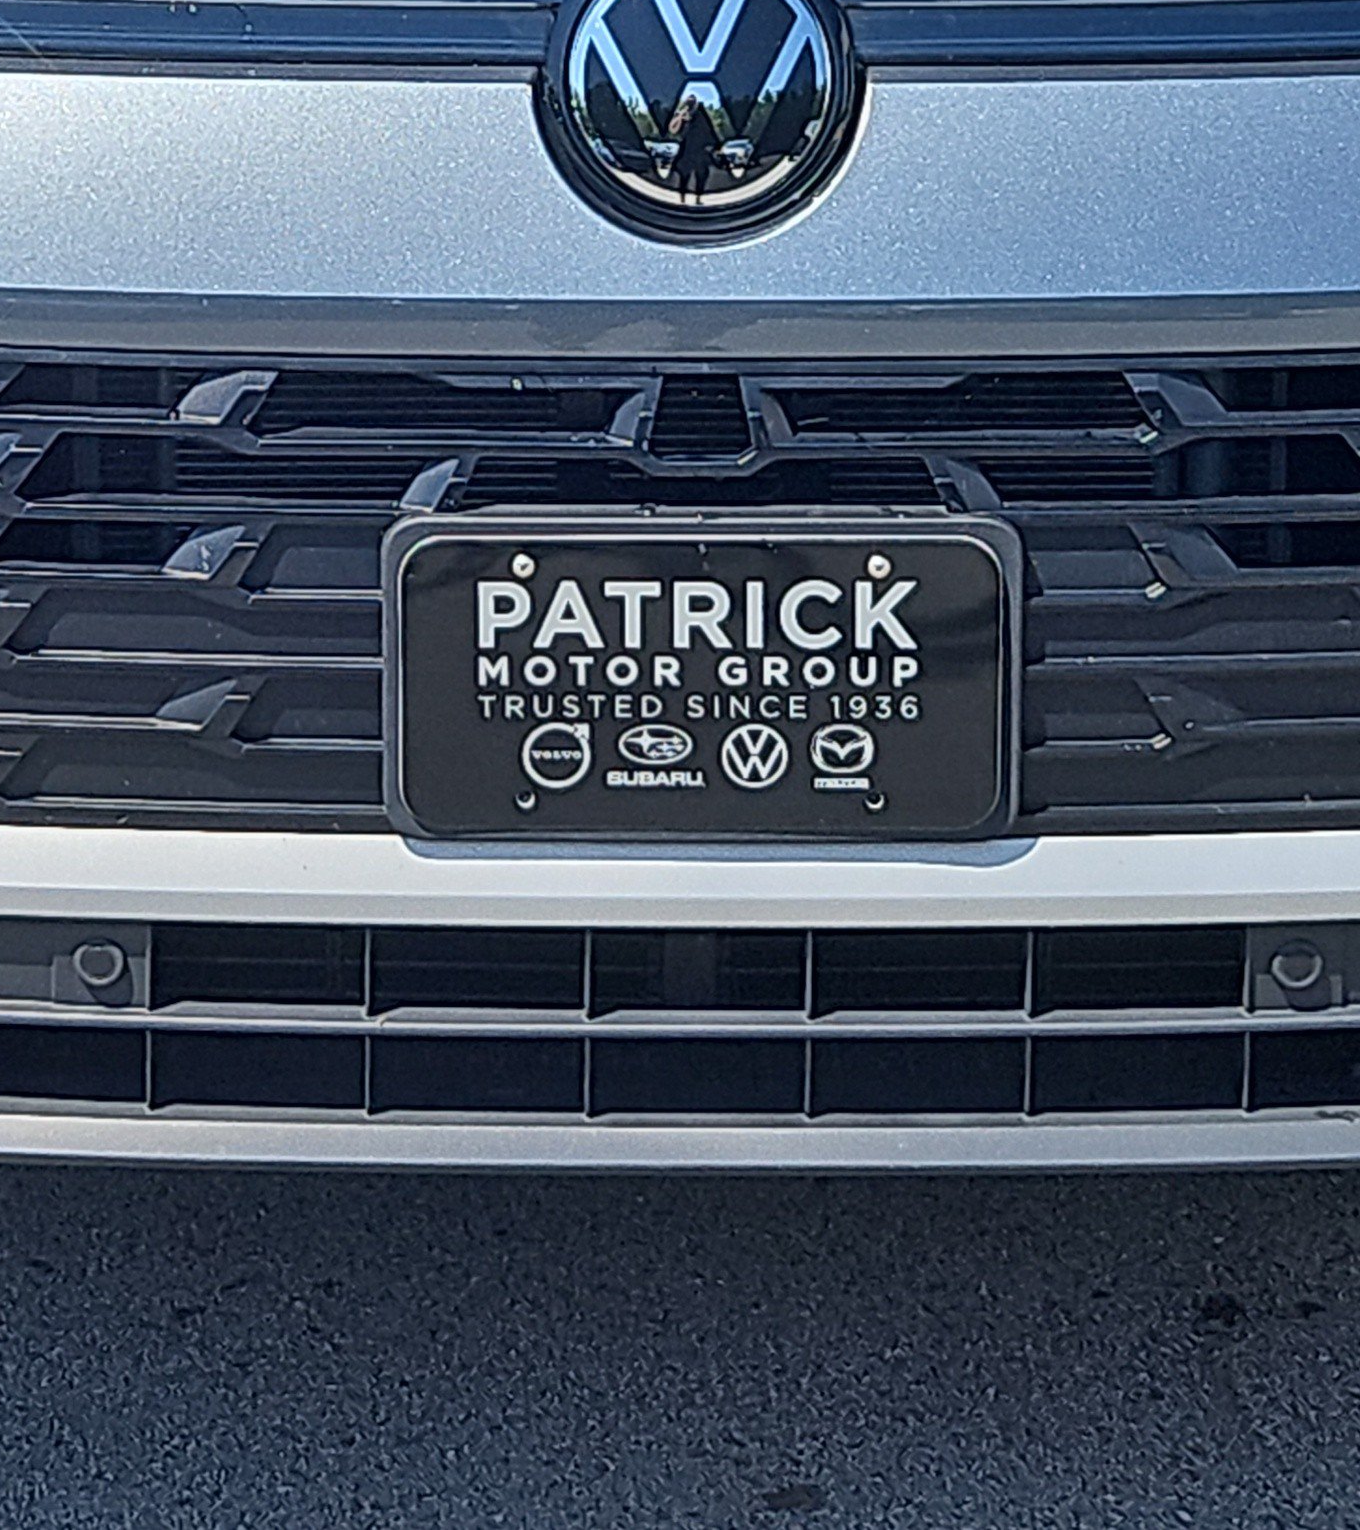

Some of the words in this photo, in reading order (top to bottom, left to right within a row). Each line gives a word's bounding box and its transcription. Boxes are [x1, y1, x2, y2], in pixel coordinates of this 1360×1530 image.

[477, 579, 918, 650] PATRICK
[477, 655, 682, 688] MOTOR
[717, 655, 919, 689] GROUP
[477, 694, 664, 719] TRUSTED
[686, 694, 808, 719] SINCE
[830, 694, 919, 719] 1936
[530, 748, 583, 761] VOLVO
[606, 770, 707, 787] SUBARU
